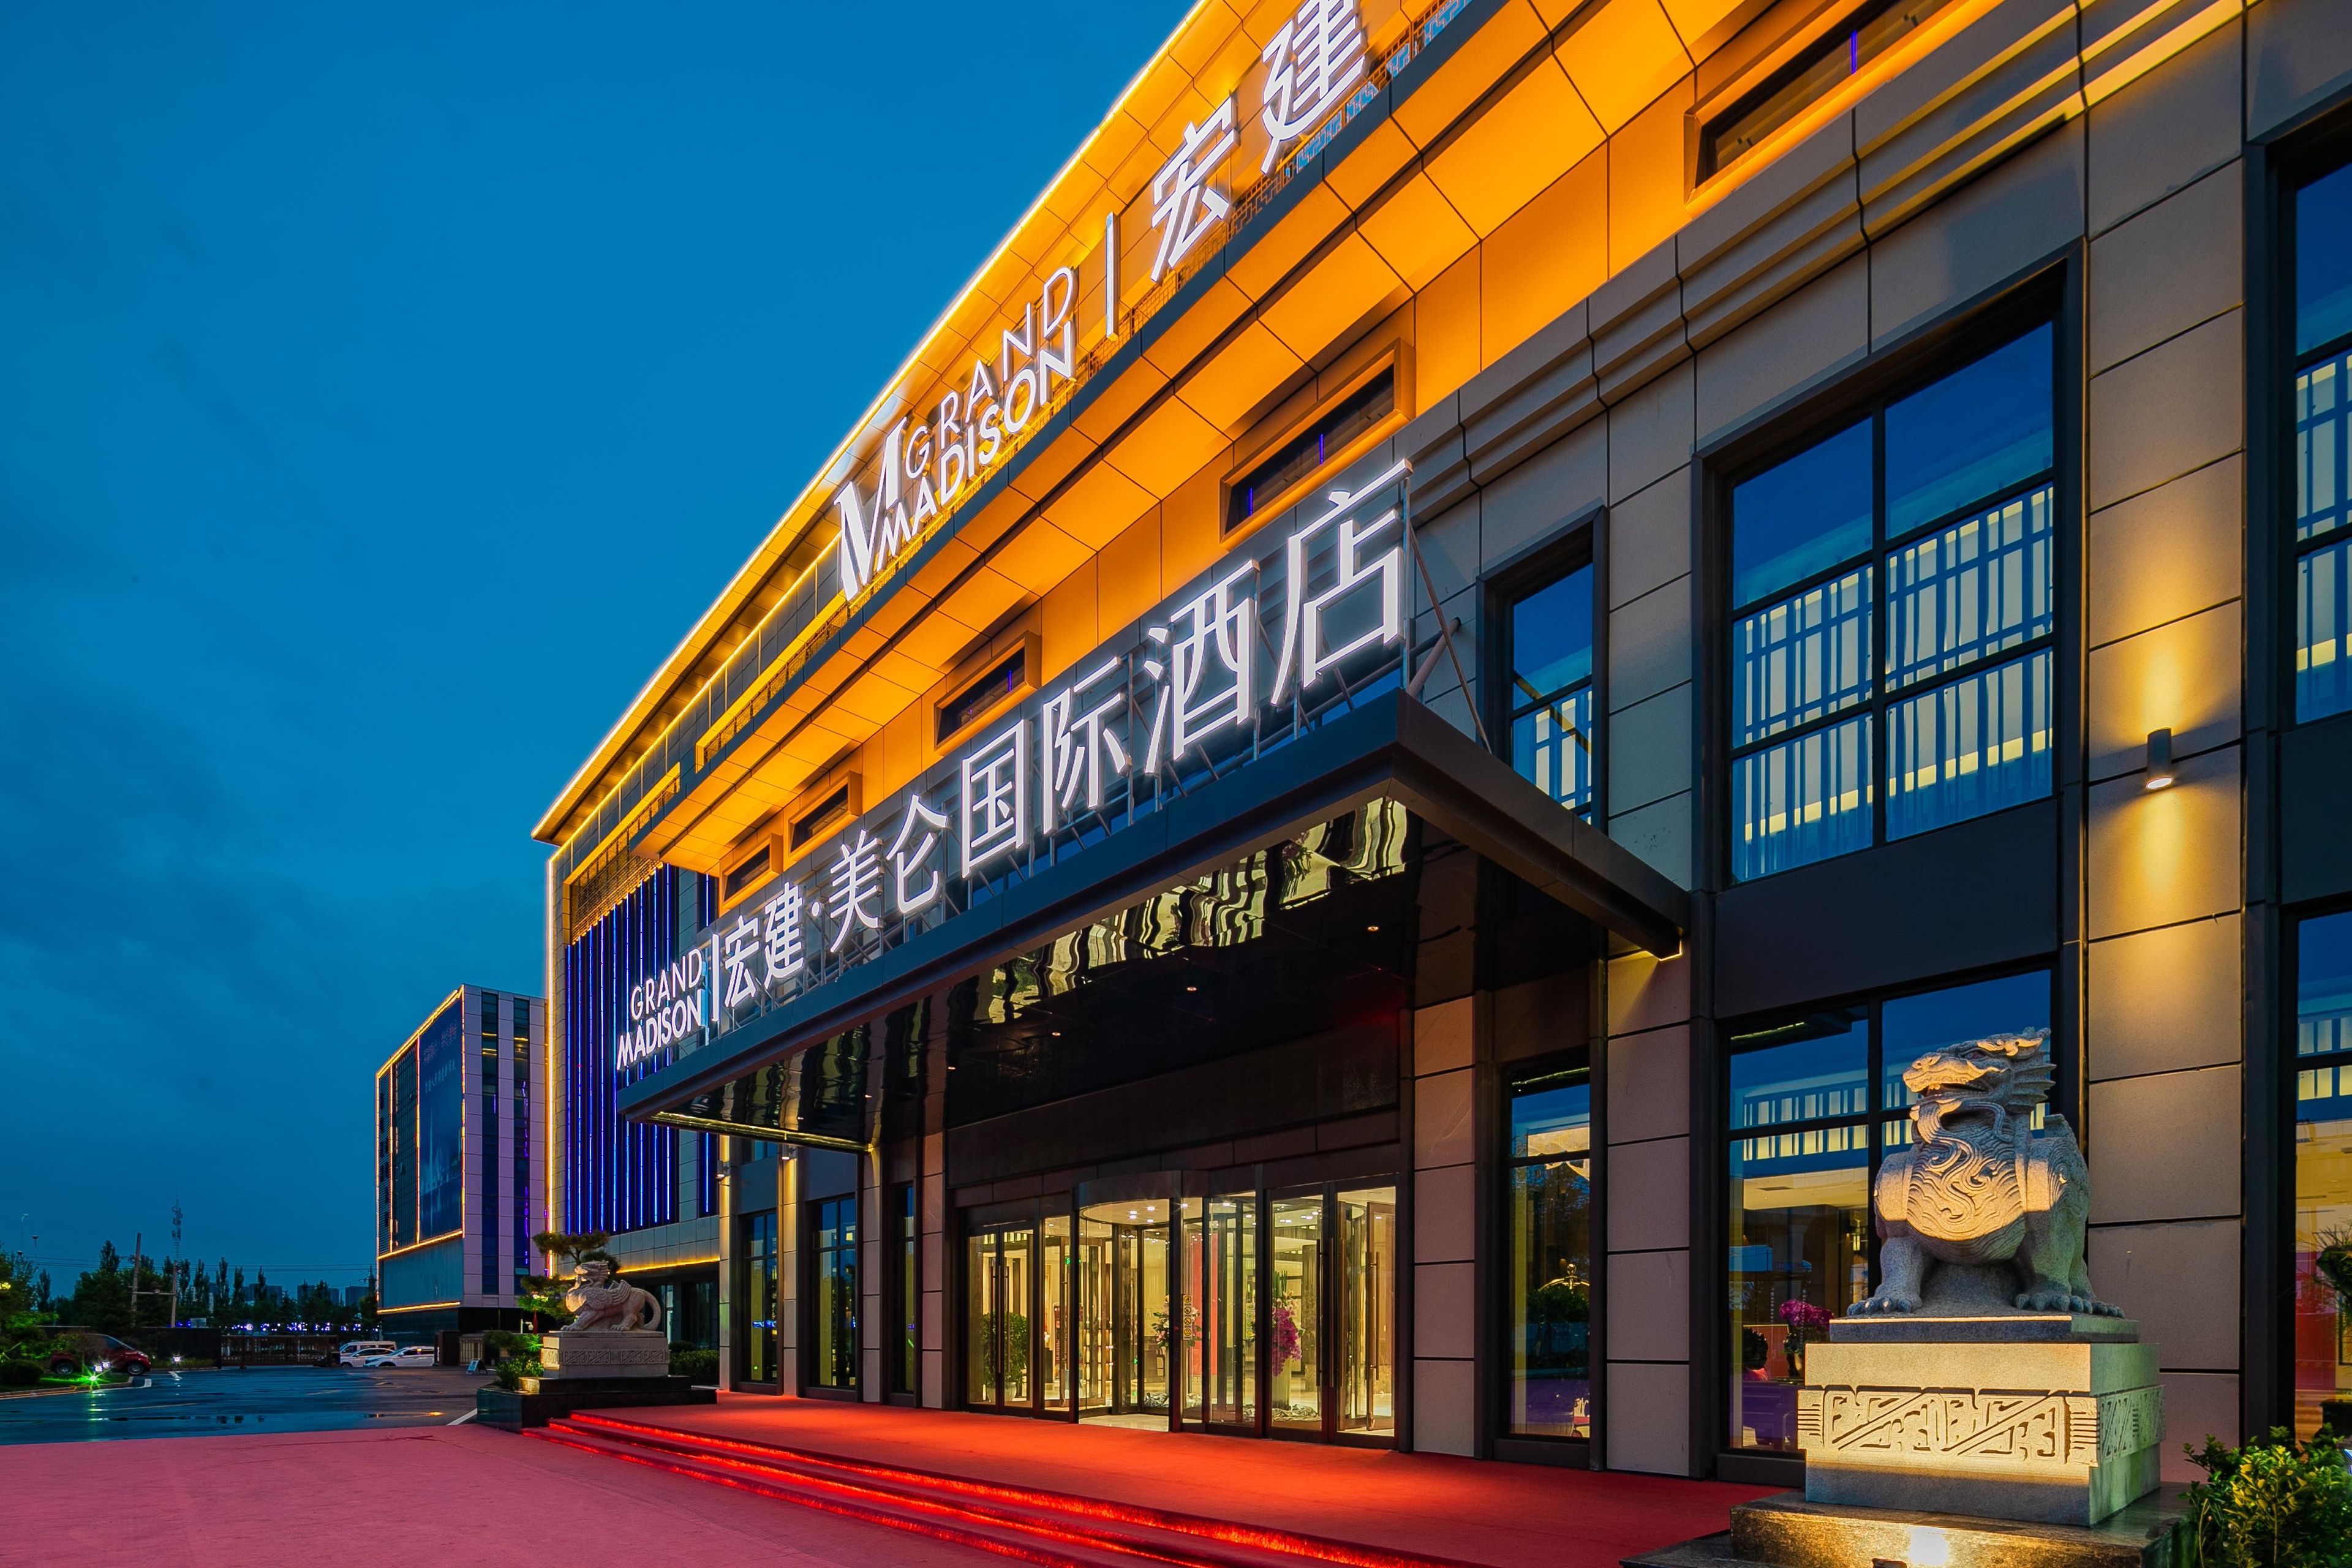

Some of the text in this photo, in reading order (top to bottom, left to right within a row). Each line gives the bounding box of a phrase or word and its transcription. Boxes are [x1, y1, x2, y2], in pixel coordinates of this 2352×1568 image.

[1150, 0, 1367, 282] 宏建
[876, 320, 1076, 572] MADISON
[905, 266, 1076, 479] GRAND
[616, 988, 704, 1071] MADISON
[631, 947, 703, 1021] GRAND
